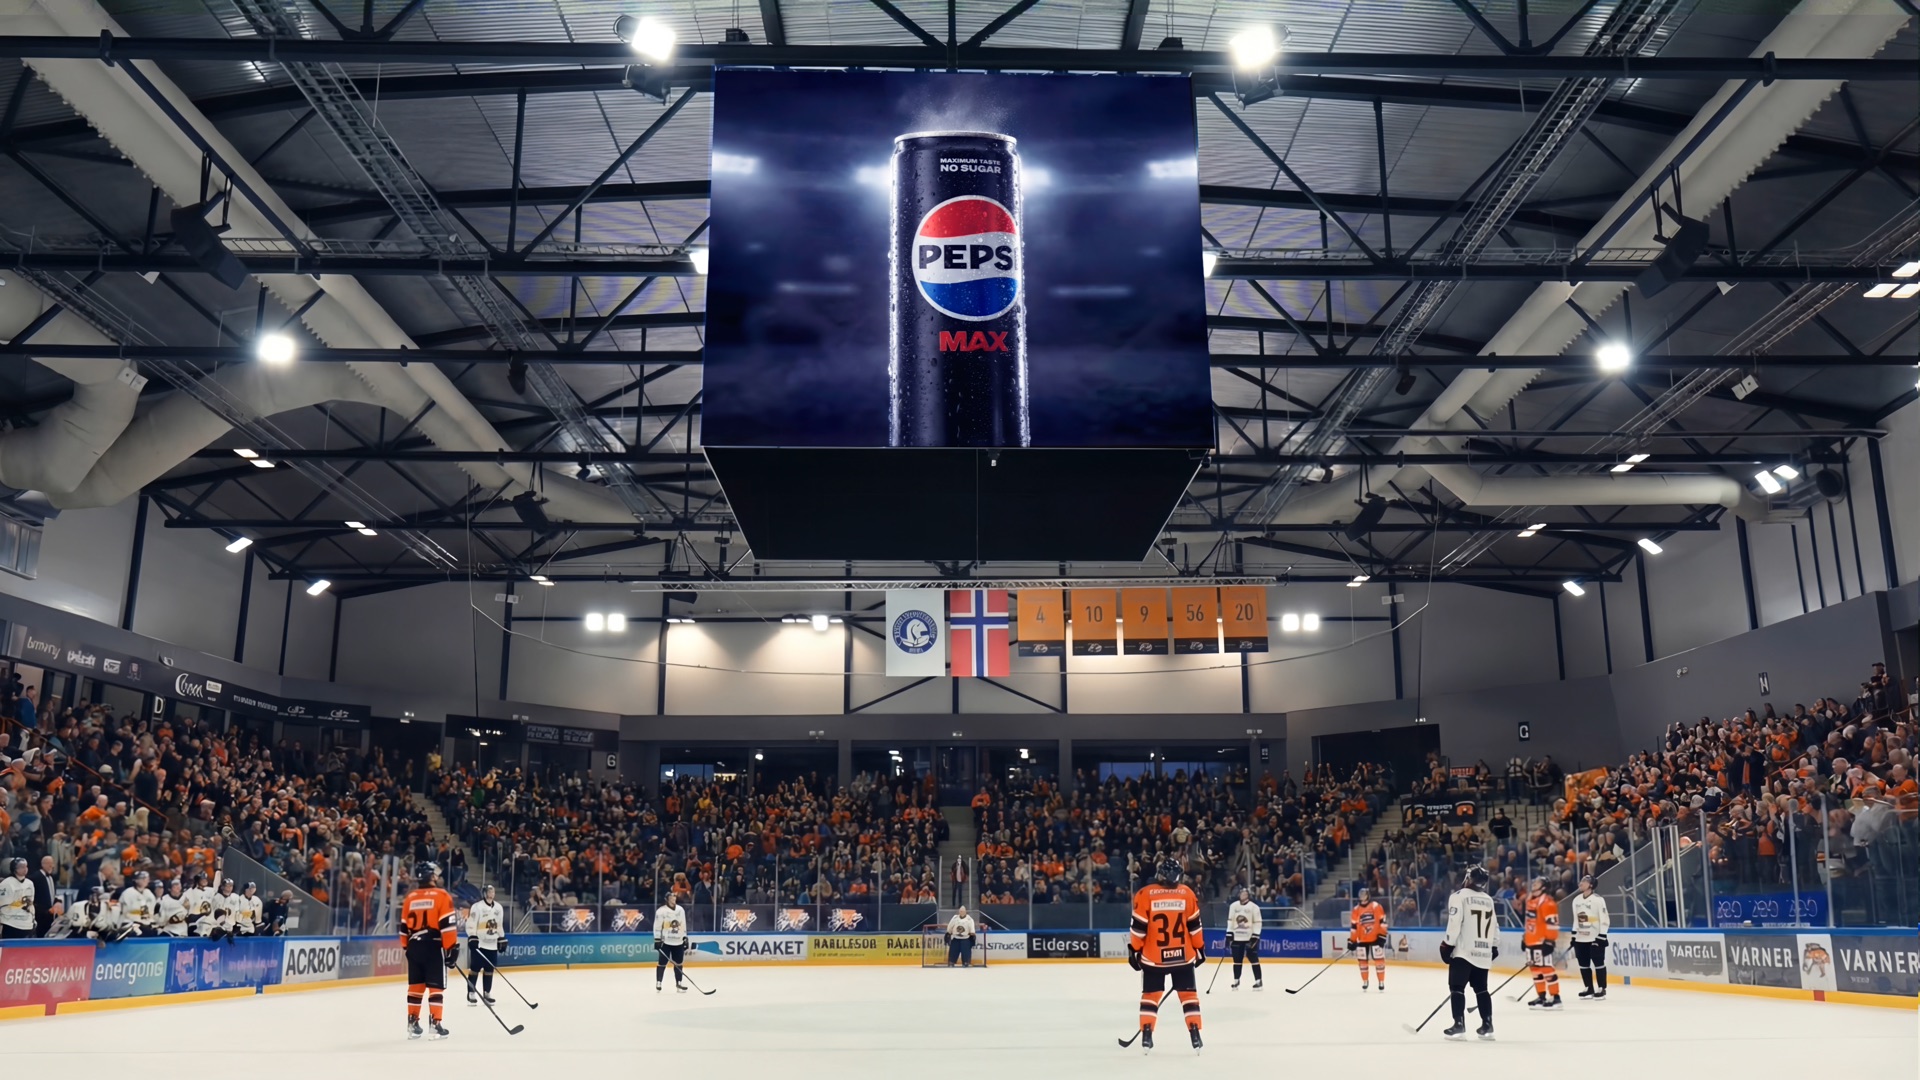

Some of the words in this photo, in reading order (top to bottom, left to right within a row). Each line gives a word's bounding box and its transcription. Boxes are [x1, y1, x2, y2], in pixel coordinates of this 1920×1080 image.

[940, 164, 959, 172] NO
[960, 164, 1001, 174] SUGAR
[939, 331, 1009, 352] MAX
[1036, 605, 1046, 623] 4
[1085, 605, 1103, 623] 10
[1140, 605, 1149, 623] 9
[1186, 604, 1204, 622] 56
[1235, 603, 1254, 621] 20
[154, 696, 164, 714] D
[1152, 913, 1186, 947] 34
[725, 940, 804, 955] SKAAKET
[1730, 945, 1793, 968] VARNER
[1839, 948, 1919, 975] VARNER
